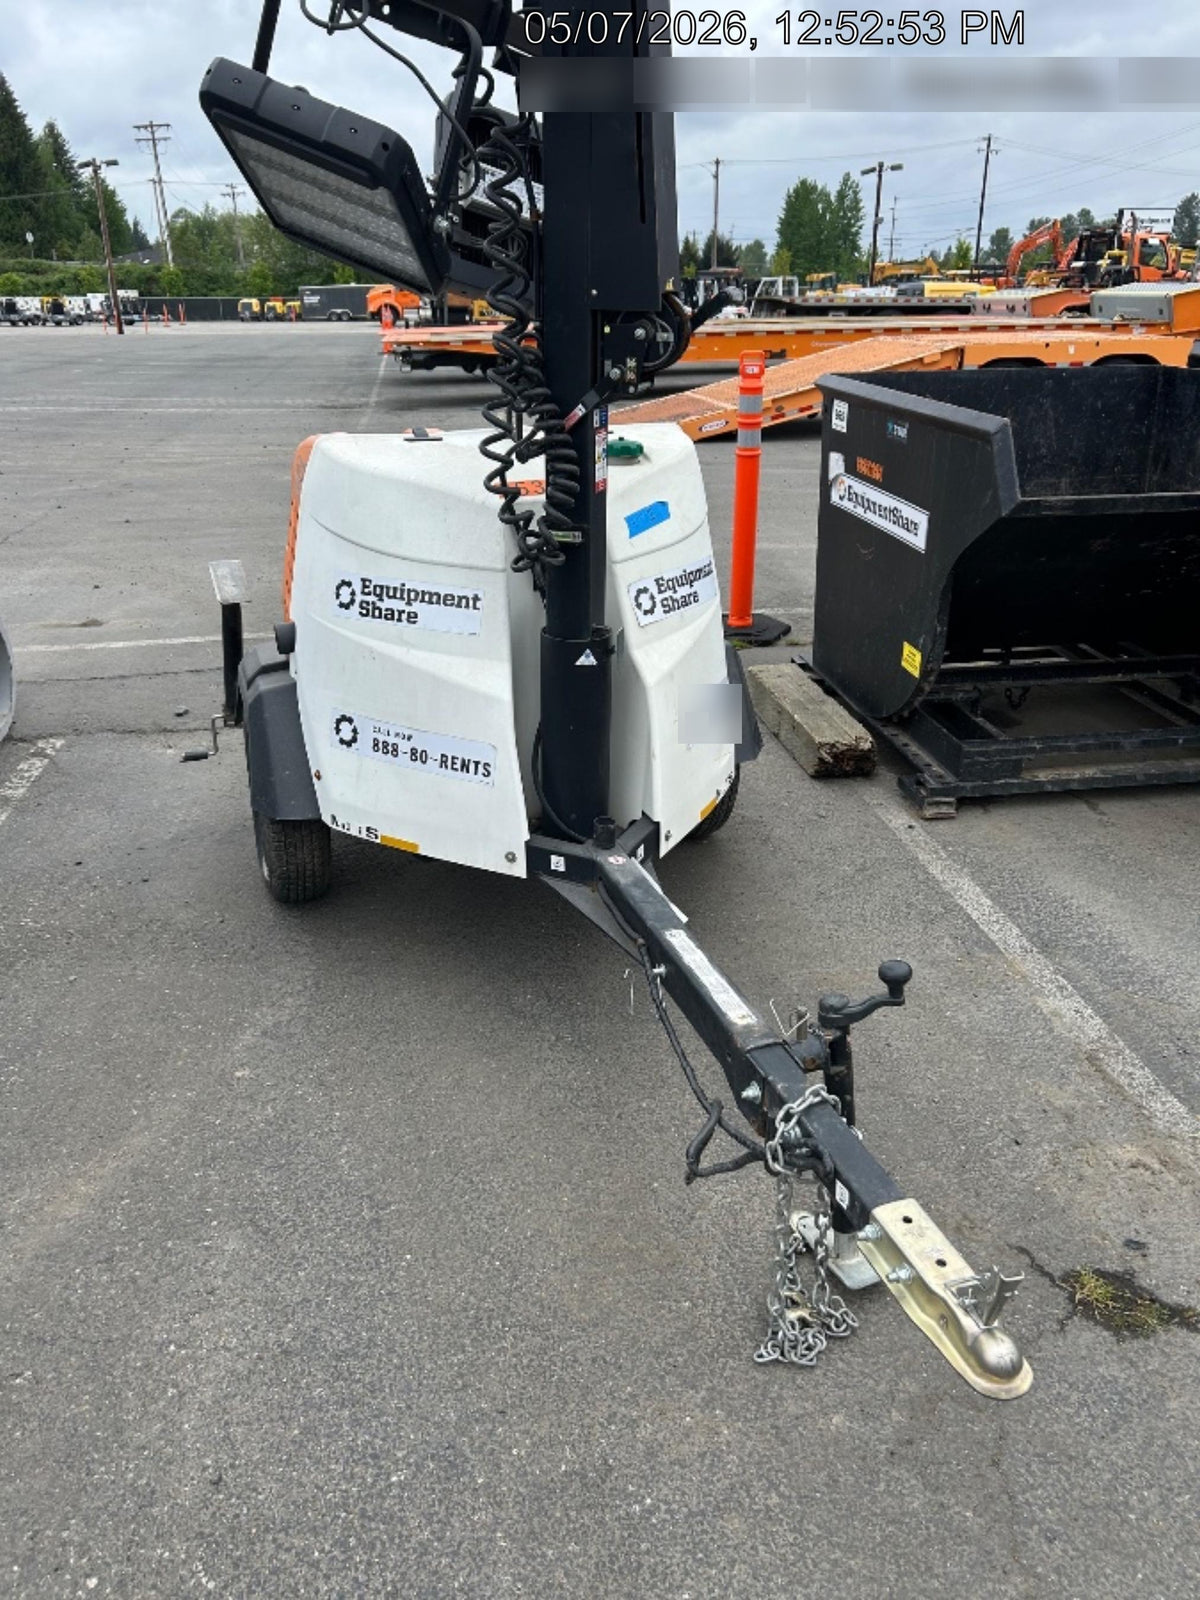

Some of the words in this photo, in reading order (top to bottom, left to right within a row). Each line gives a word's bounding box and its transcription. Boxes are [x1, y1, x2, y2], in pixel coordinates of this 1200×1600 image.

[359, 577, 481, 611] Equipment
[660, 590, 700, 615] Share
[358, 600, 418, 624] Share
[373, 737, 492, 778] 888-80-RENTS
